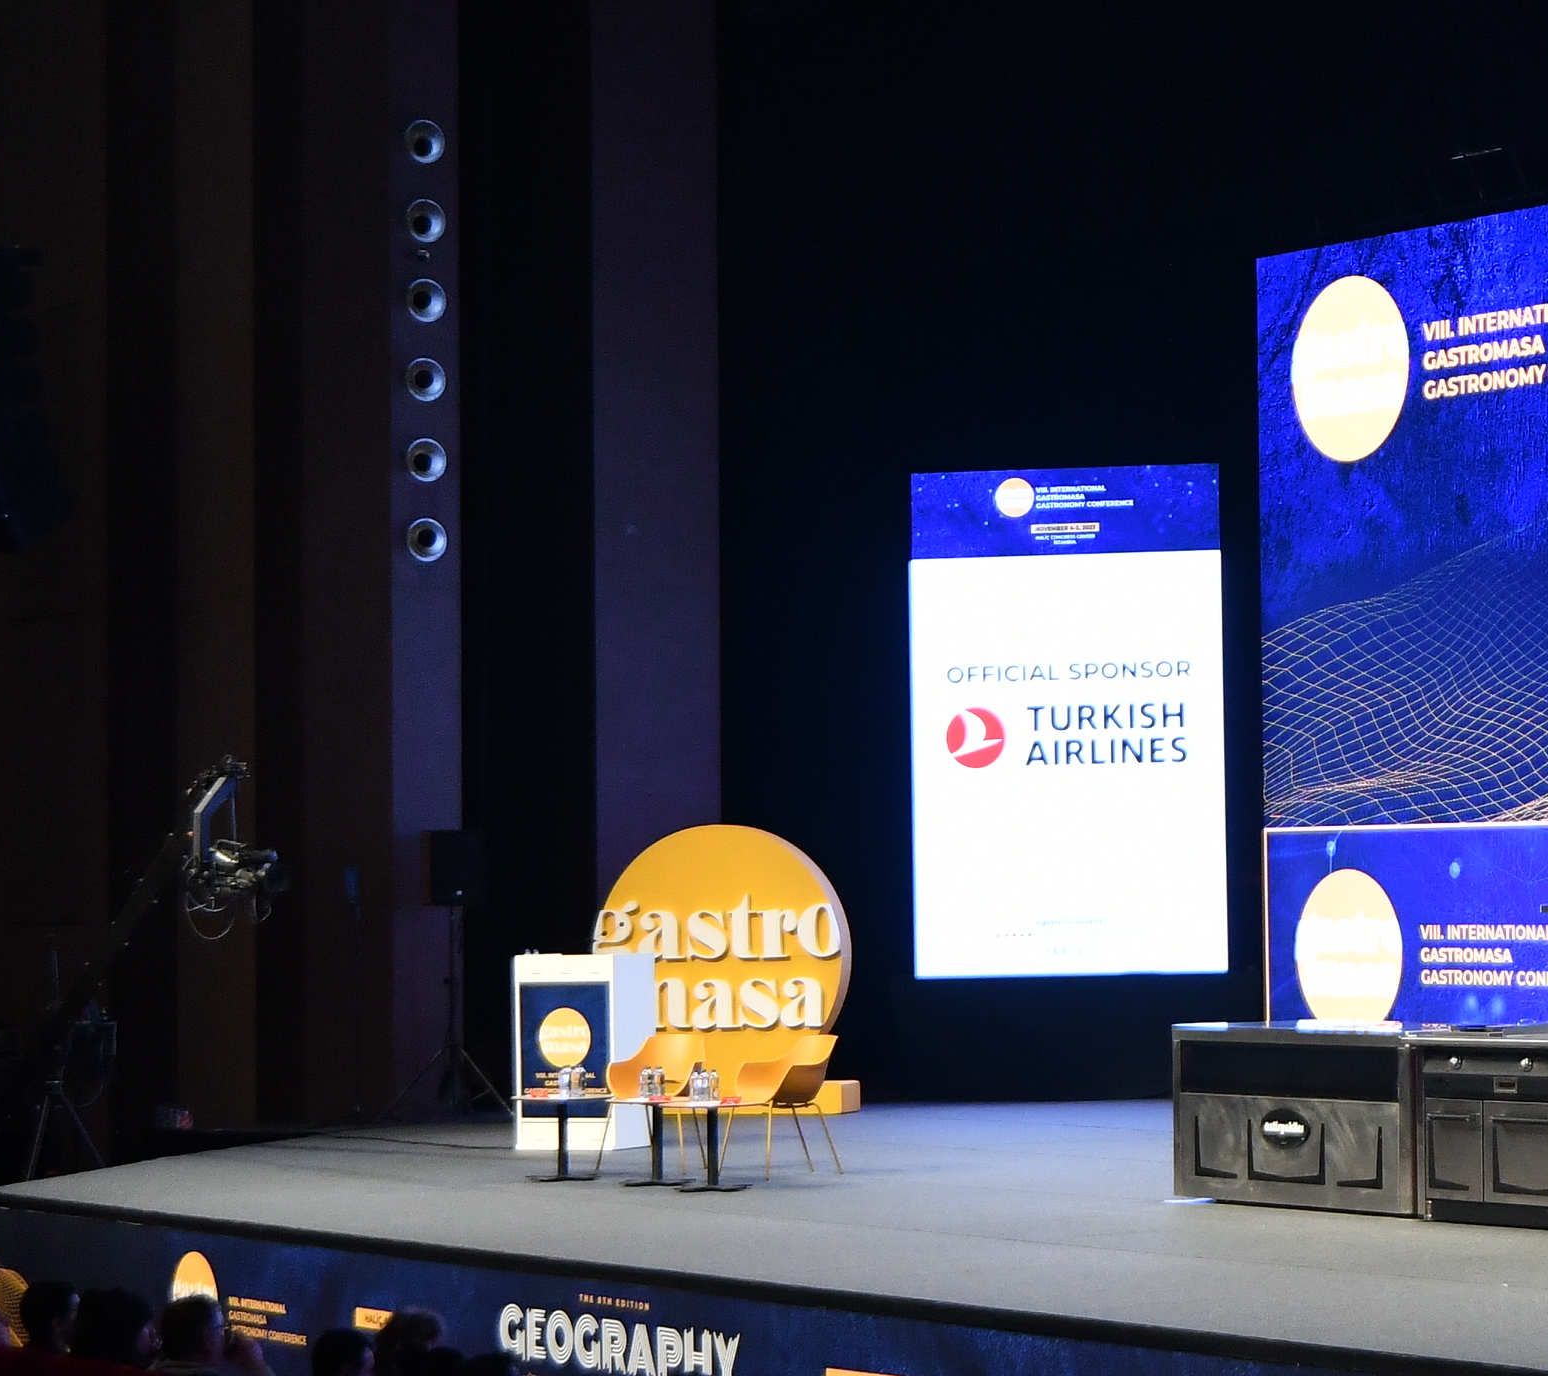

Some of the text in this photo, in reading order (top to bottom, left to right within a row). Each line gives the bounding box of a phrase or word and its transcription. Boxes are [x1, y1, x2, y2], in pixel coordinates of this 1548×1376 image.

[1422, 319, 1455, 342] VIII.
[1423, 334, 1545, 370] GASTROMASA
[1423, 363, 1547, 400] GASTRONOMY
[946, 659, 1191, 684] OFFICIAL SPONSOR
[1026, 701, 1185, 733] TURKISH
[1026, 735, 1188, 767] AIRLINES
[593, 893, 842, 961] gastro
[1420, 924, 1444, 941] VIII.
[1420, 946, 1513, 963] GASTROMASA
[1420, 969, 1514, 986] GASTRONOMY
[579, 1293, 594, 1303] THE
[615, 1297, 650, 1311] EDITION
[268, 1329, 307, 1345] CONFERENCE
